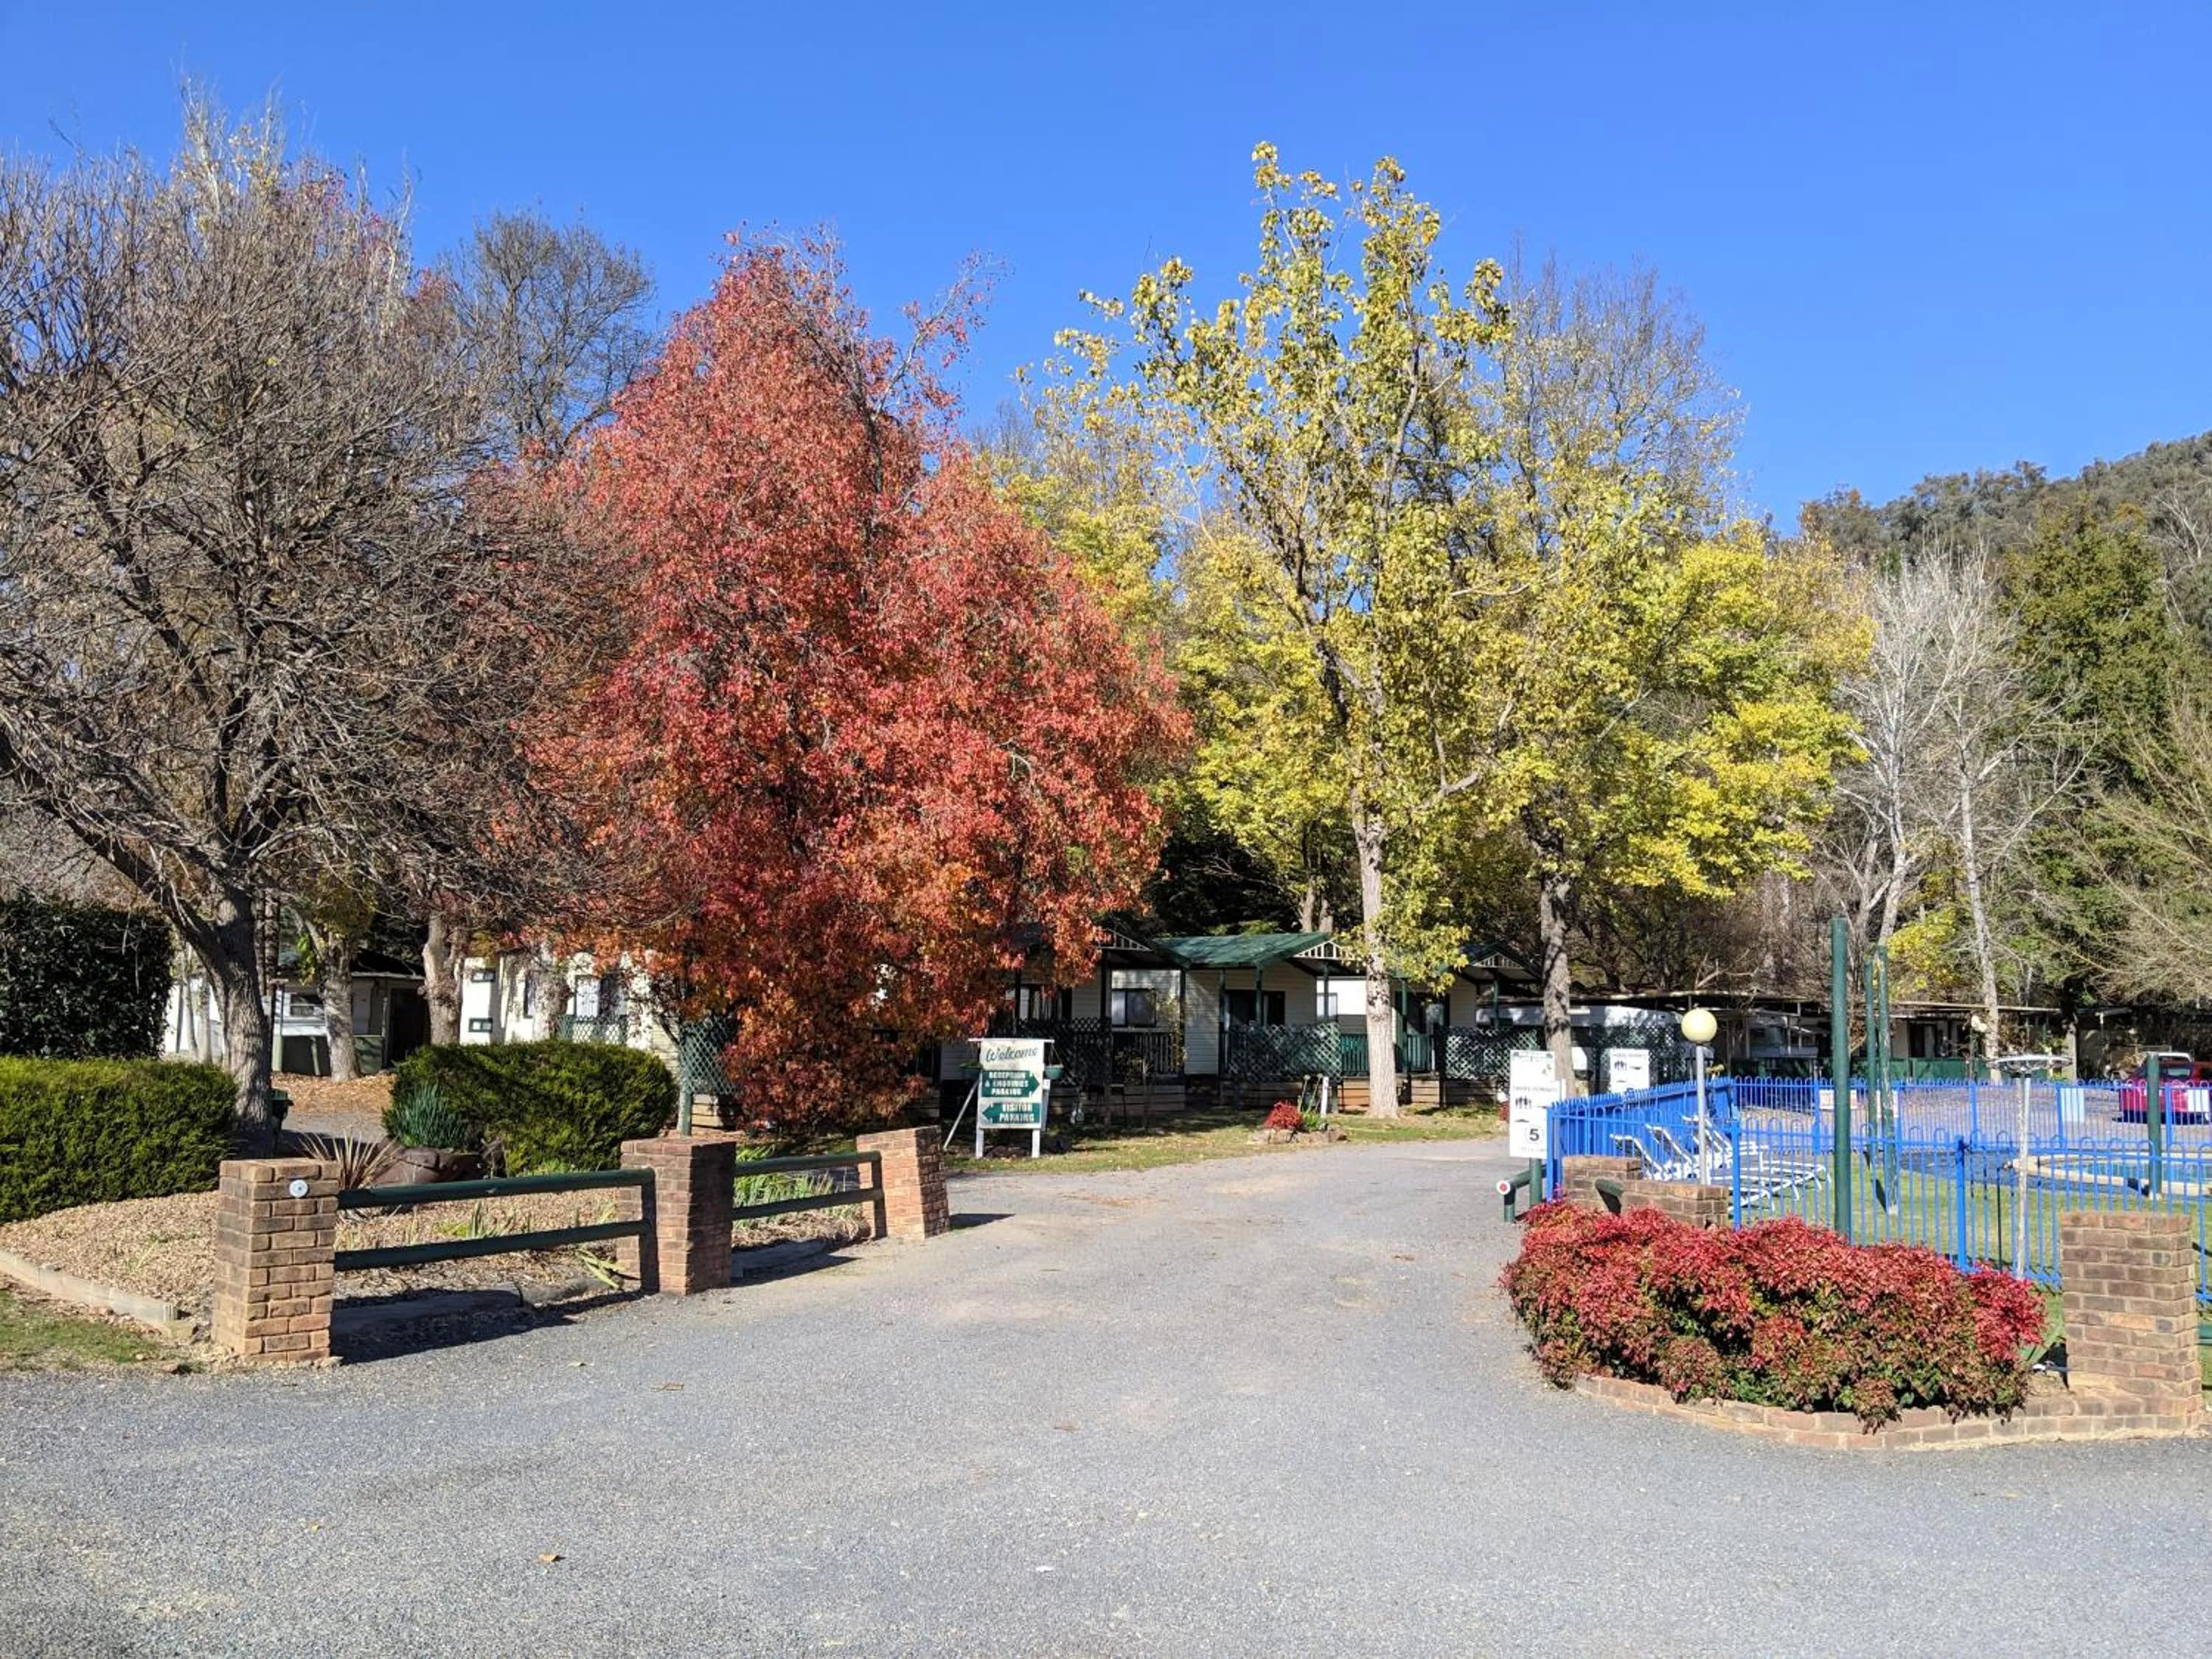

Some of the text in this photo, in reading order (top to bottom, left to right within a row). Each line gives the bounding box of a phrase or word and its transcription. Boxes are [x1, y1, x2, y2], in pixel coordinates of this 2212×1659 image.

[985, 1046, 1039, 1062] Welcome
[991, 1088, 1022, 1096] PARKING
[1003, 1103, 1033, 1113] VISITOR
[999, 1113, 1035, 1122] PARKING
[1528, 1128, 1540, 1142] 5
